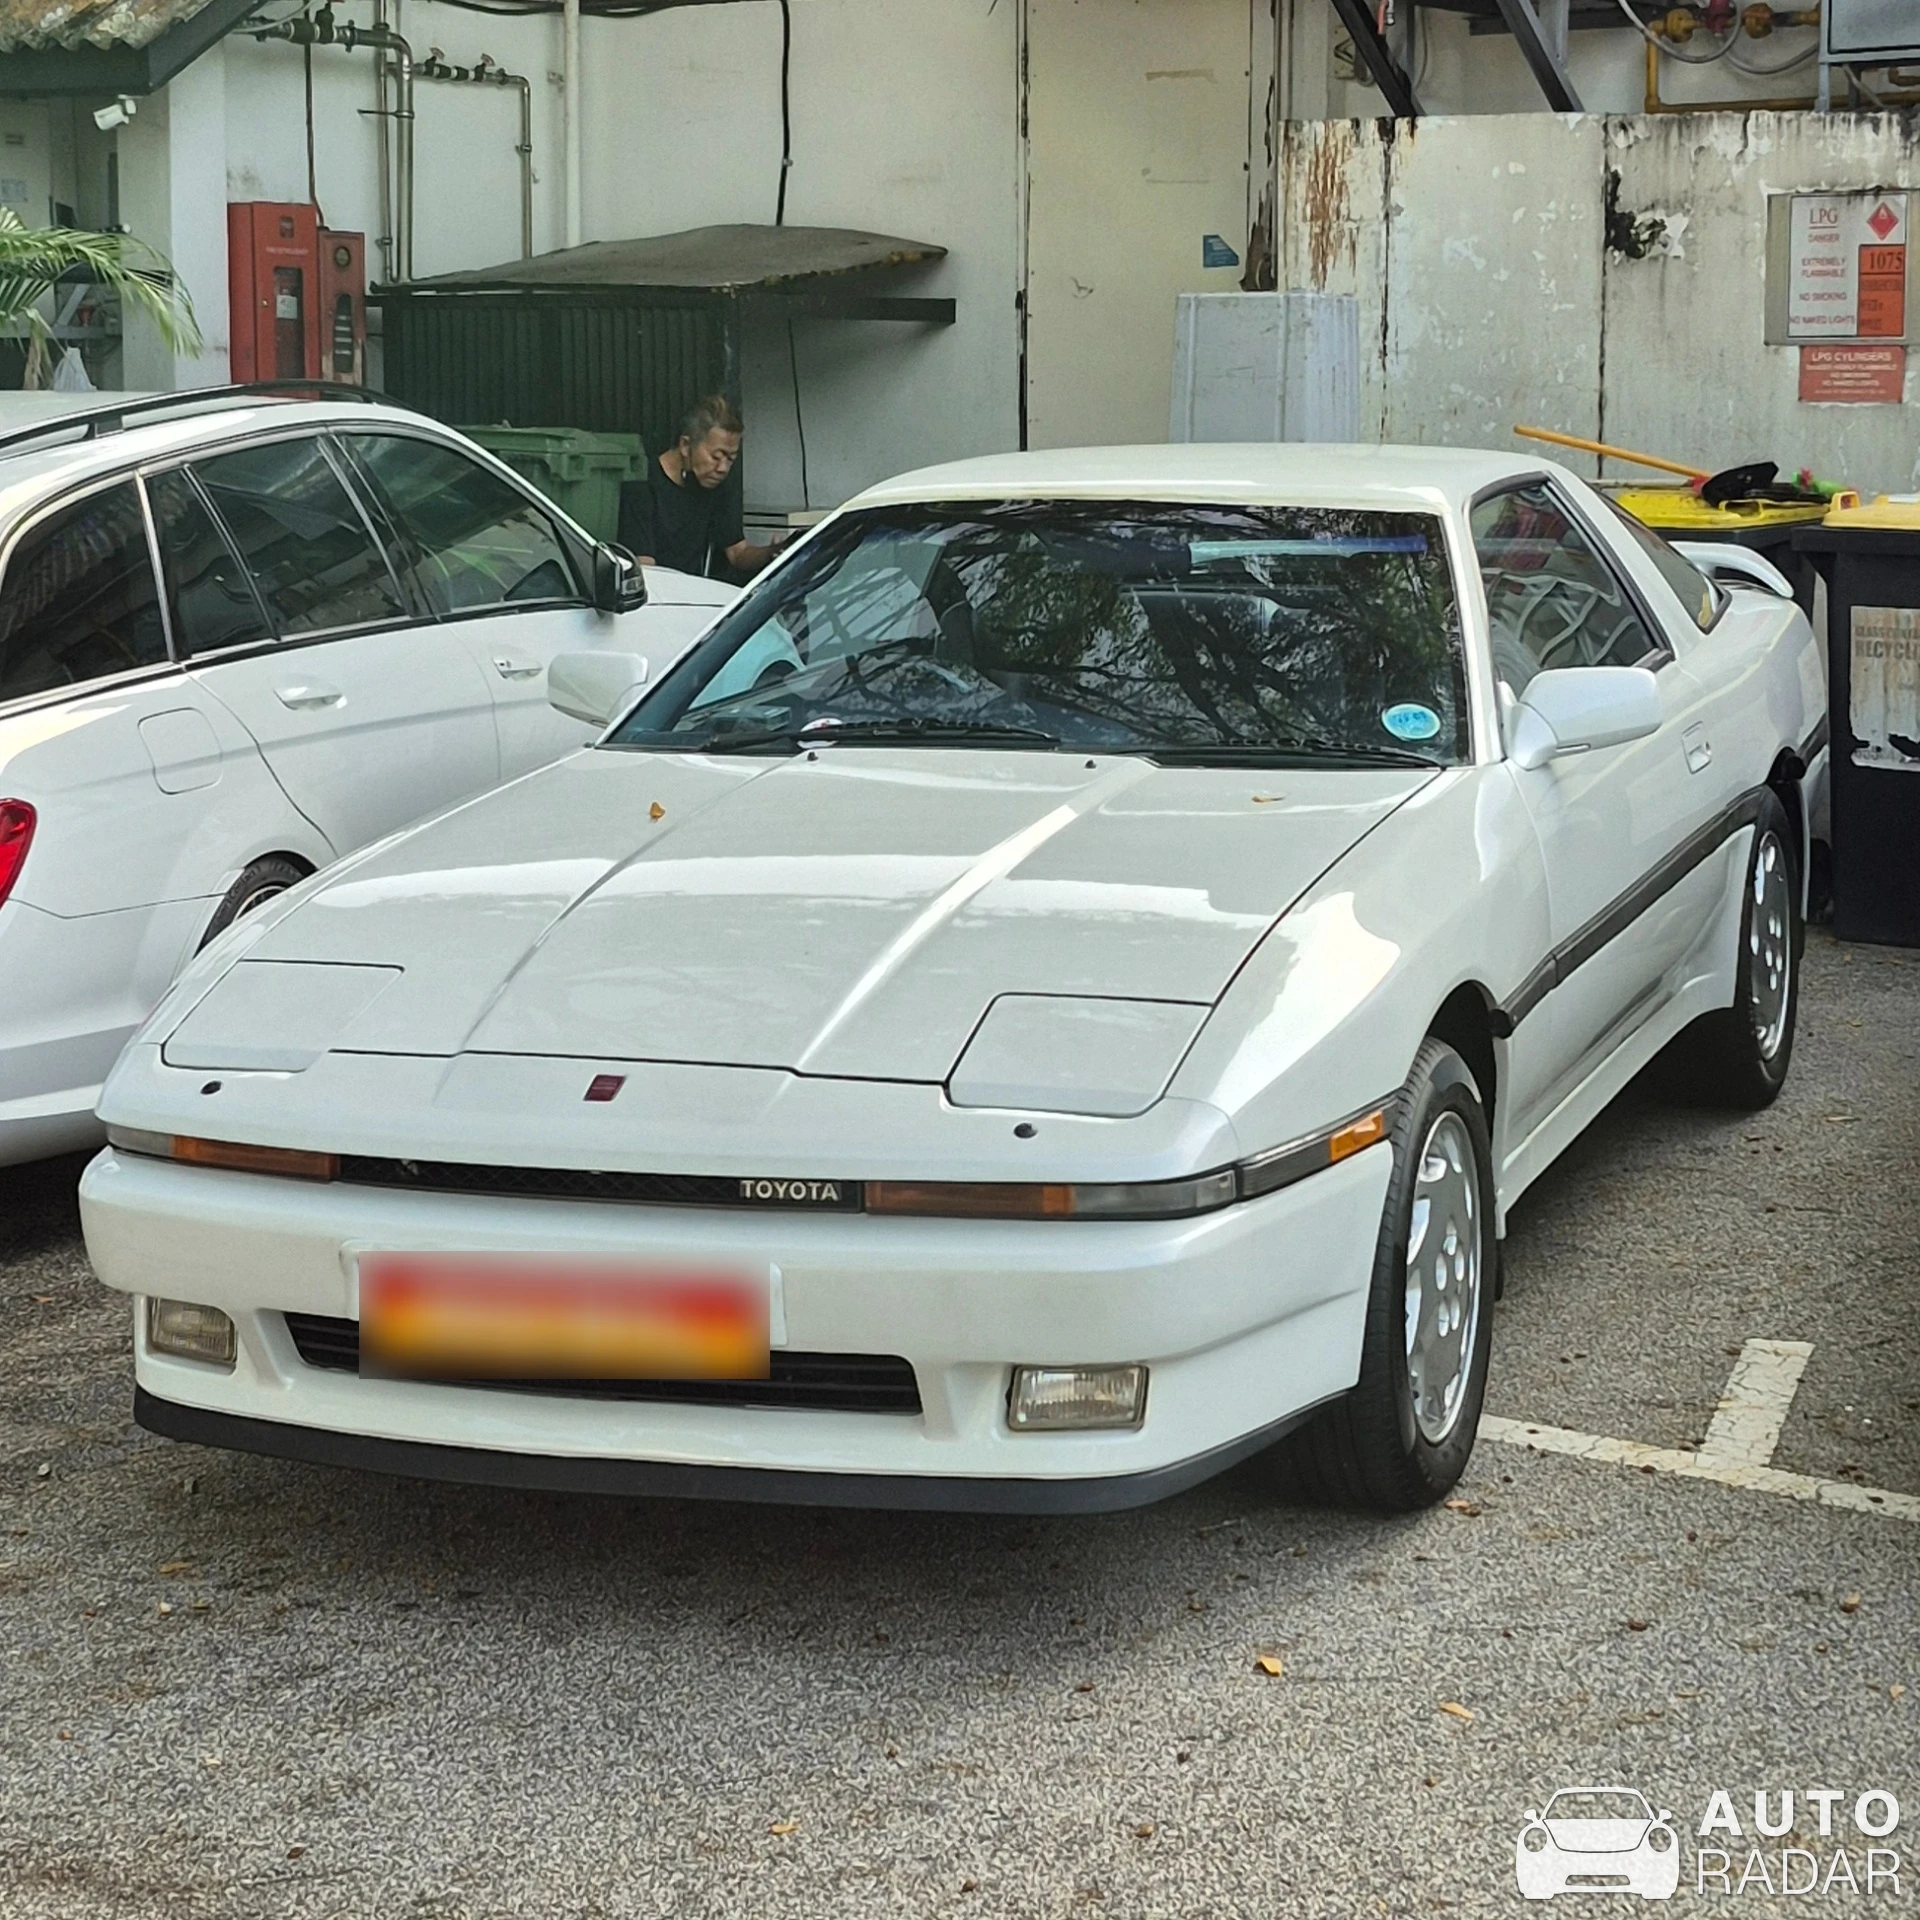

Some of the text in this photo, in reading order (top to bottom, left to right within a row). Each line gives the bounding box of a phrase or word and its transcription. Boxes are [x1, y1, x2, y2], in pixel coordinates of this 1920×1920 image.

[1809, 208, 1838, 224] LPG
[1870, 251, 1903, 270] 1075
[1811, 352, 1832, 362] LPG
[1855, 640, 1920, 660] RECYCLI
[741, 1180, 838, 1201] TOYOTA
